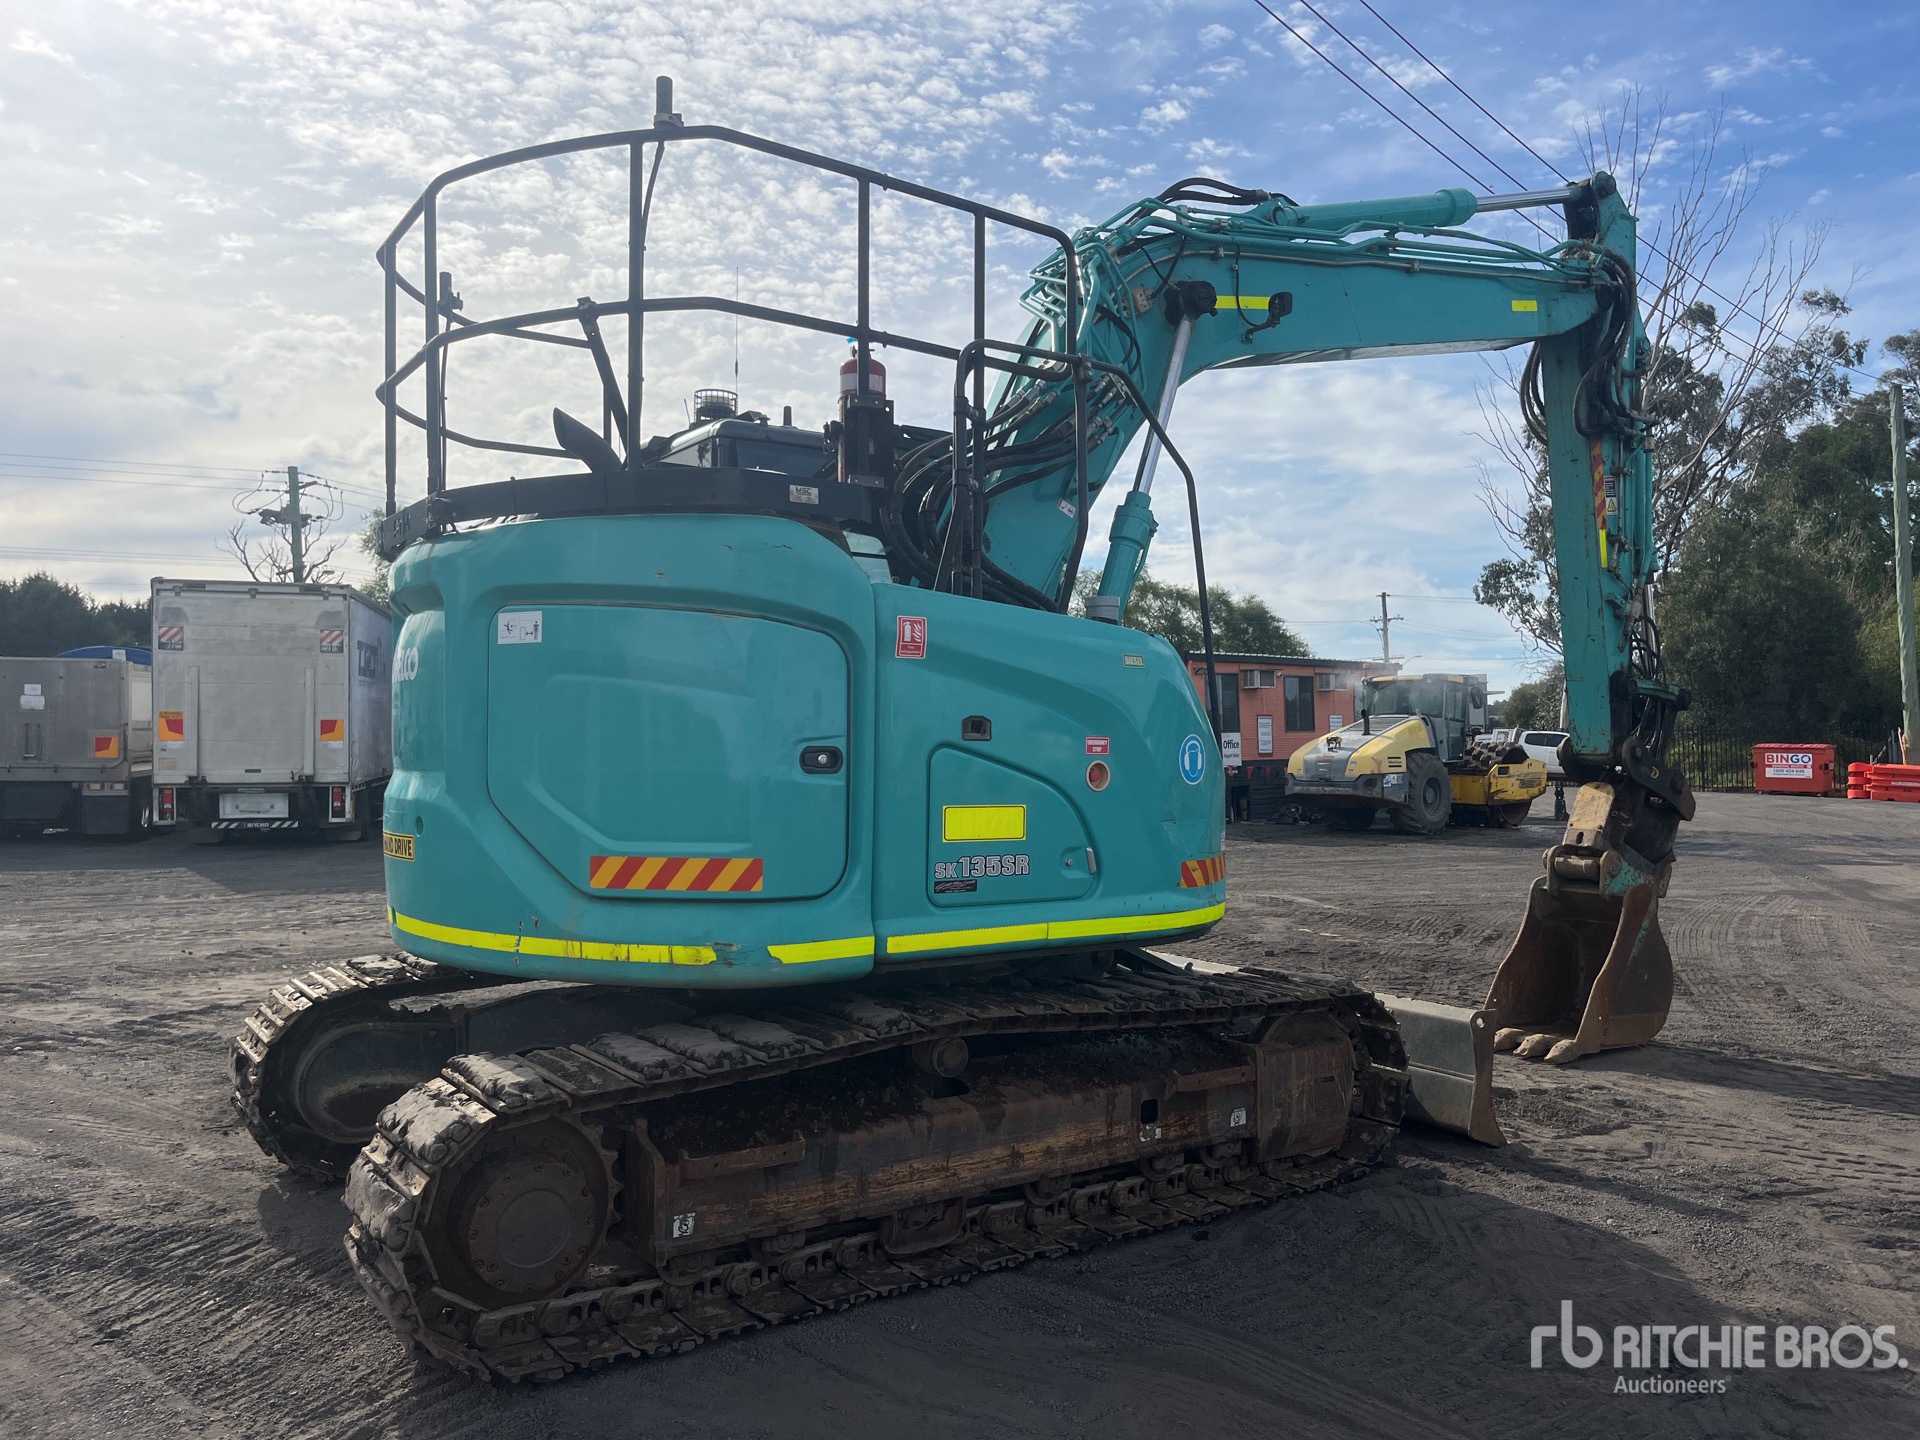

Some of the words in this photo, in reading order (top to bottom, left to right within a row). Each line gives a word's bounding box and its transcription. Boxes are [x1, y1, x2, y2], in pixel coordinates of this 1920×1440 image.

[1223, 739, 1240, 749] Office
[1766, 754, 1811, 764] BINGO
[394, 837, 413, 857] DRIVE
[934, 854, 1030, 879] SK135SR
